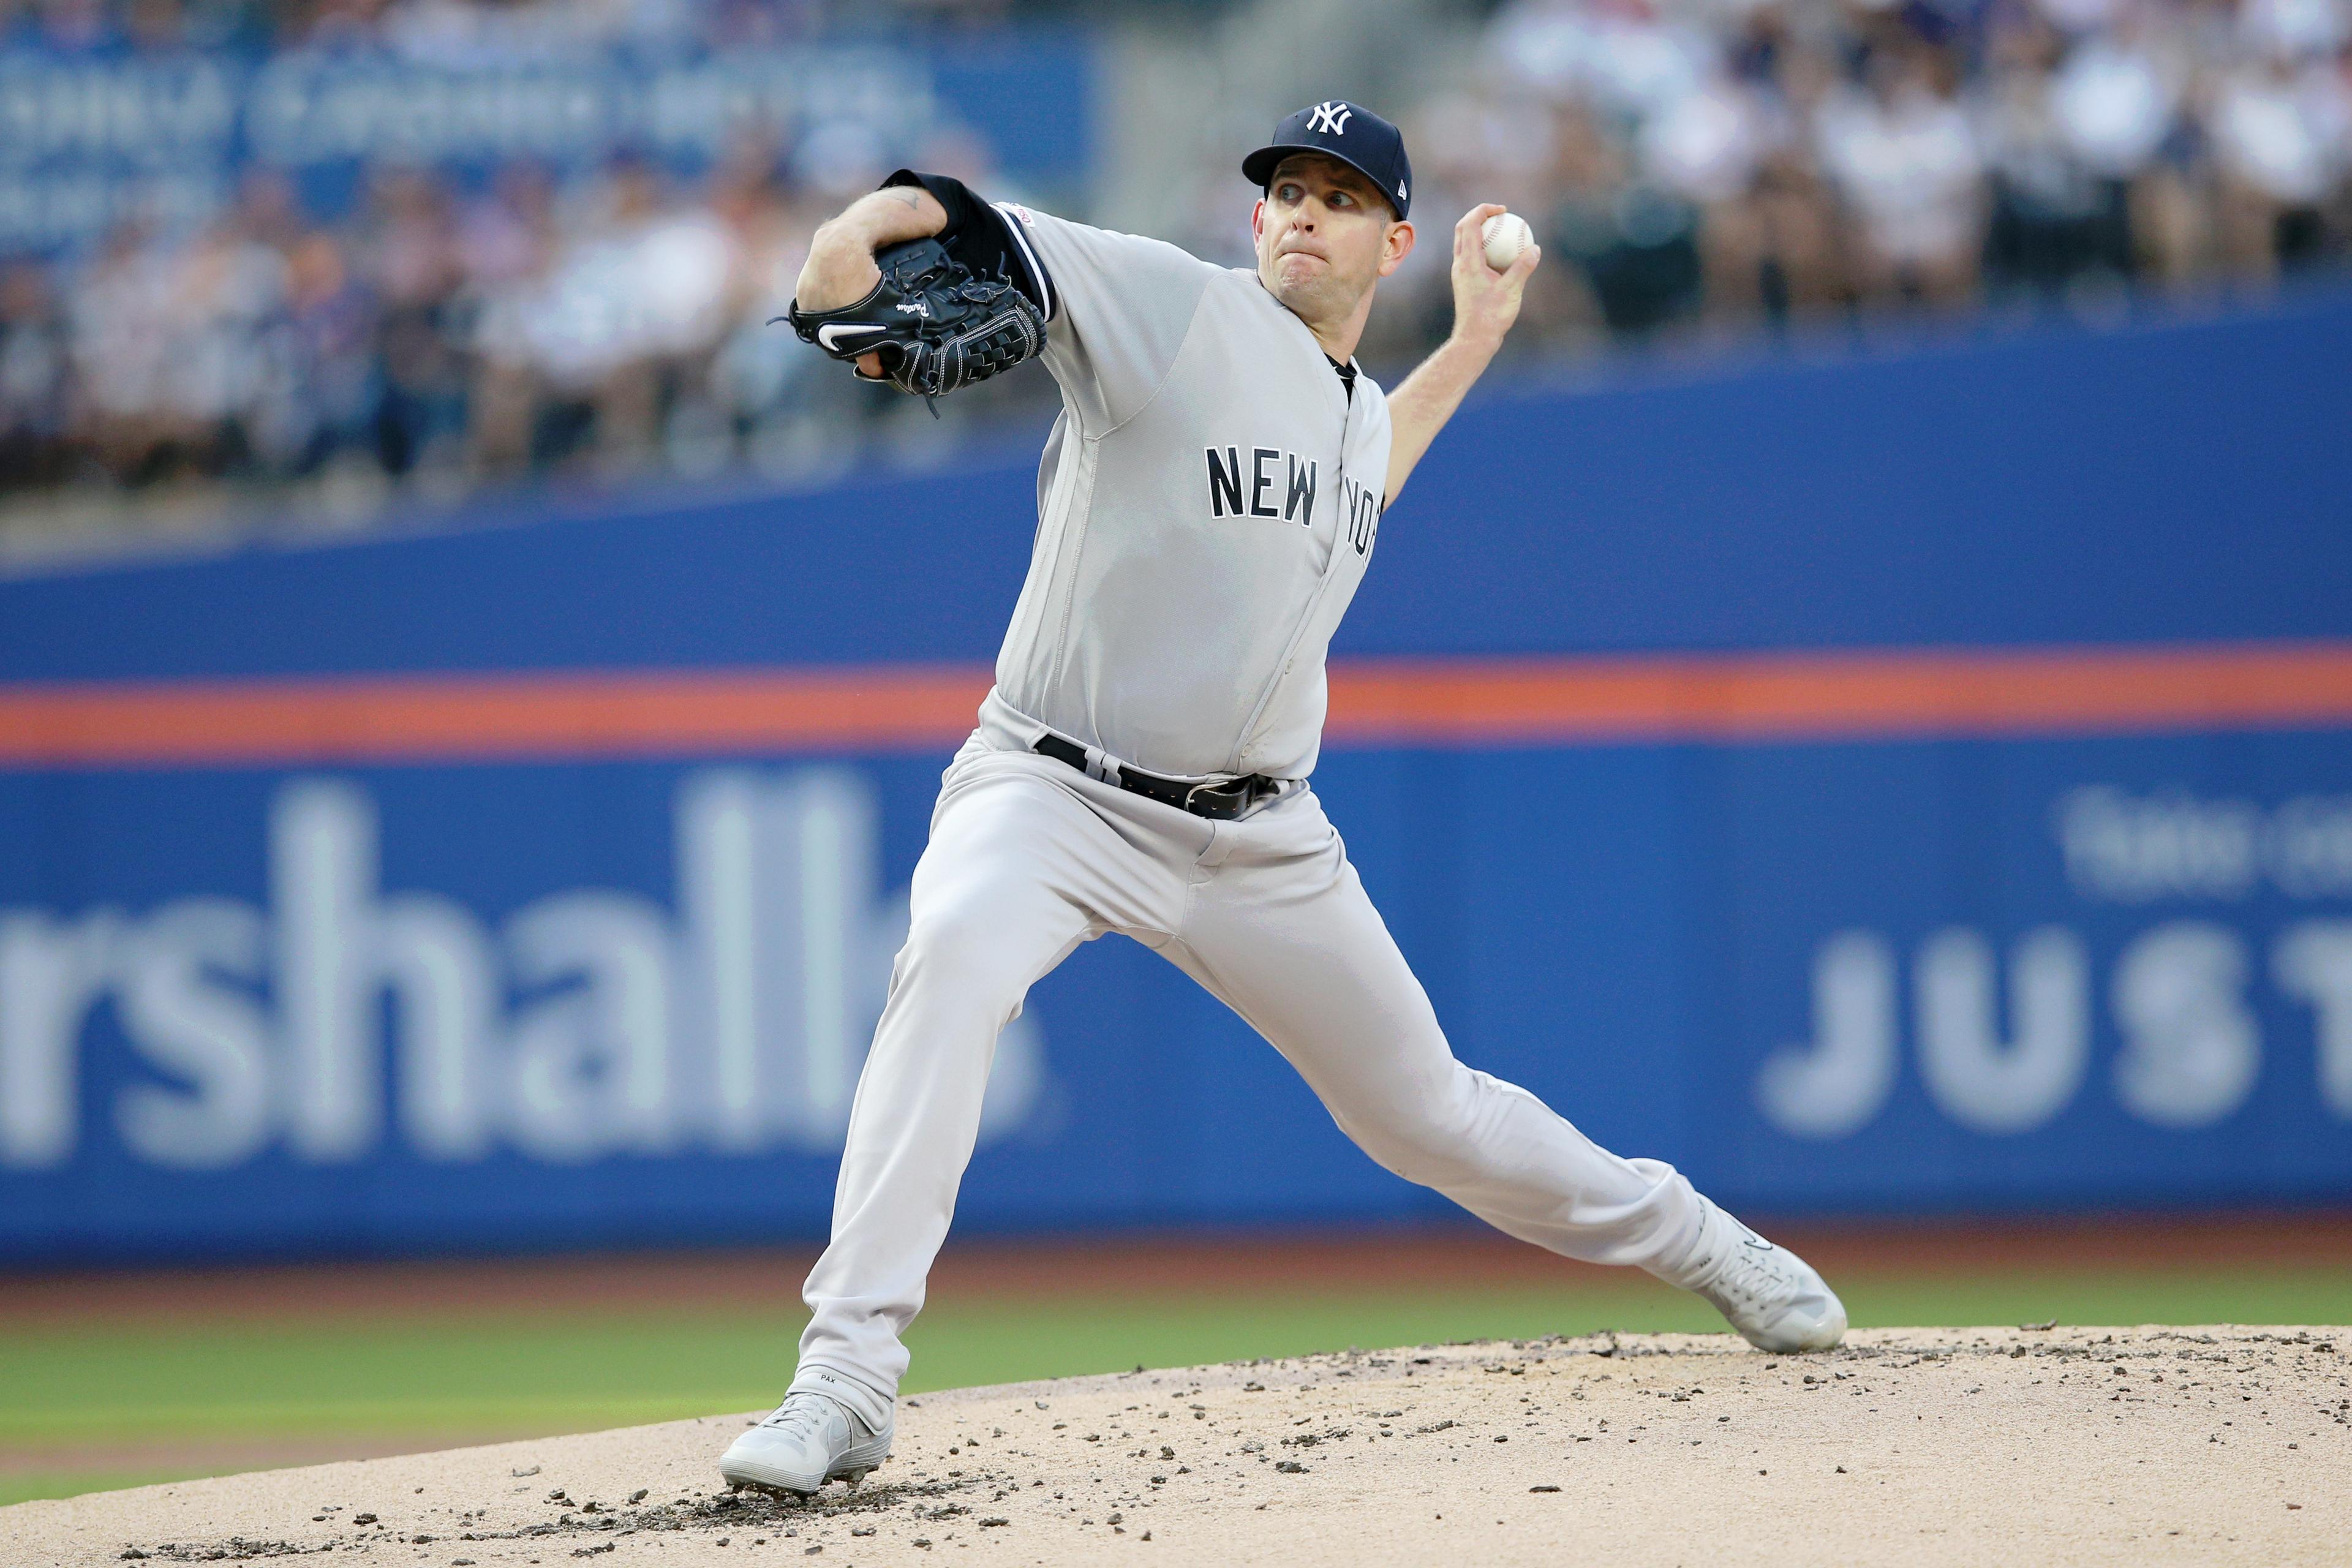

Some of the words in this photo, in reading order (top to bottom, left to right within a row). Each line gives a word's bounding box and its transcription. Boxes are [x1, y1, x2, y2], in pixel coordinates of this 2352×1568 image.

[1306, 102, 1352, 136] NY
[1204, 444, 1318, 529] NEW
[0, 769, 1045, 1169] rshall
[821, 1374, 836, 1384] PAX
